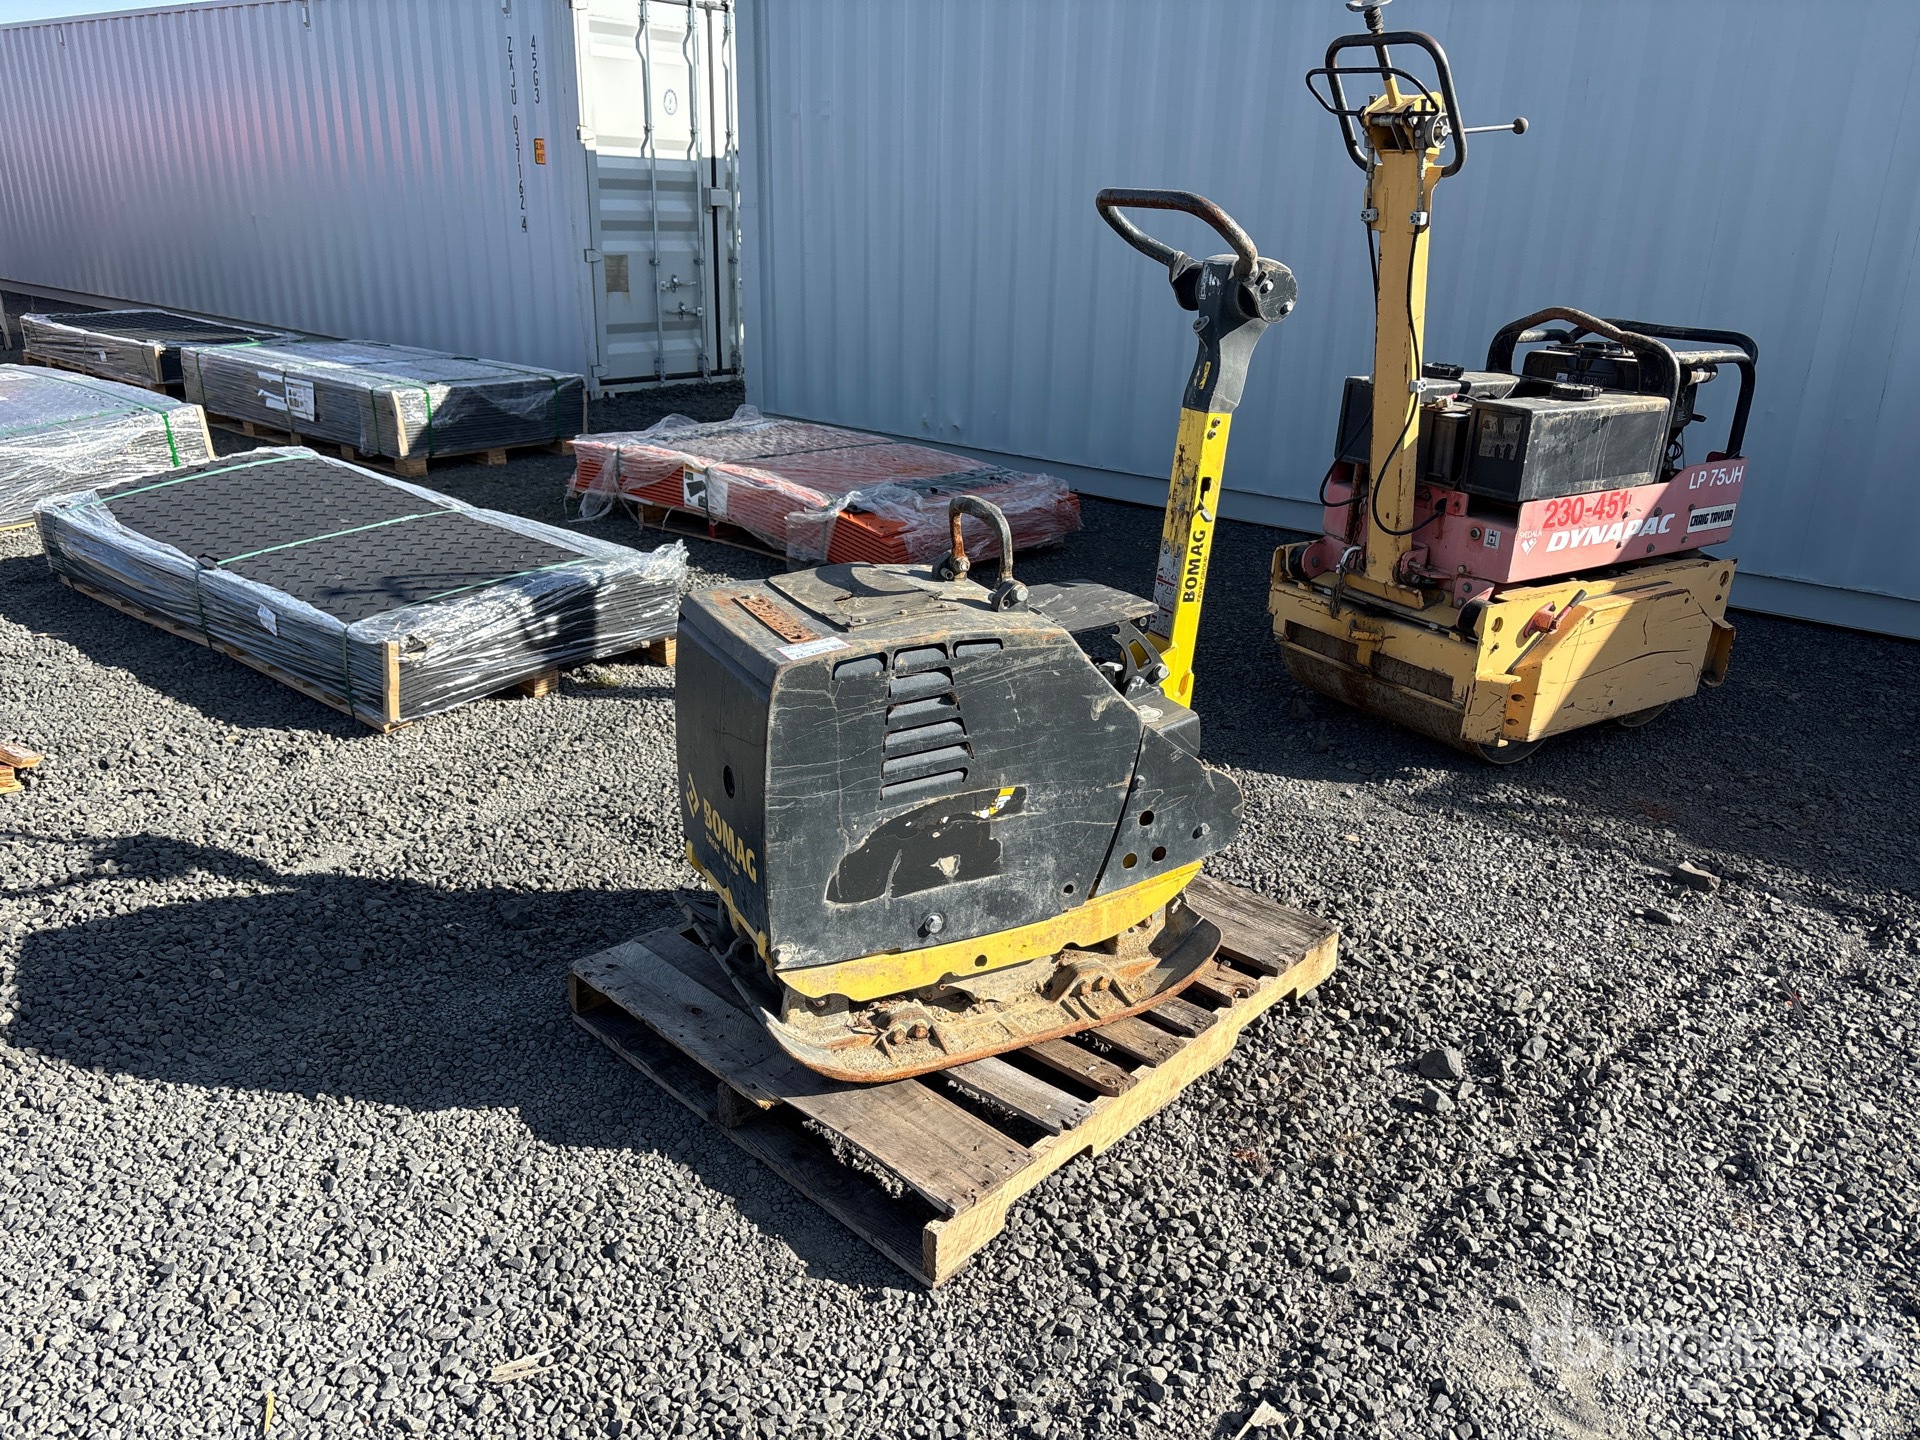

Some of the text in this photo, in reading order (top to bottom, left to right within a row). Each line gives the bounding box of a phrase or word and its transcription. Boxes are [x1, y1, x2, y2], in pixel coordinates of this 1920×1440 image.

[531, 34, 540, 104] 45G3
[507, 36, 517, 105] ZXJU
[512, 114, 525, 210] 037162
[1688, 472, 1707, 490] LP
[1545, 513, 1676, 553] DYNAPAC
[1690, 509, 1734, 527] CRAIG TAYLOR
[1182, 529, 1206, 603] BOMAG
[703, 797, 757, 884] BOMAG
